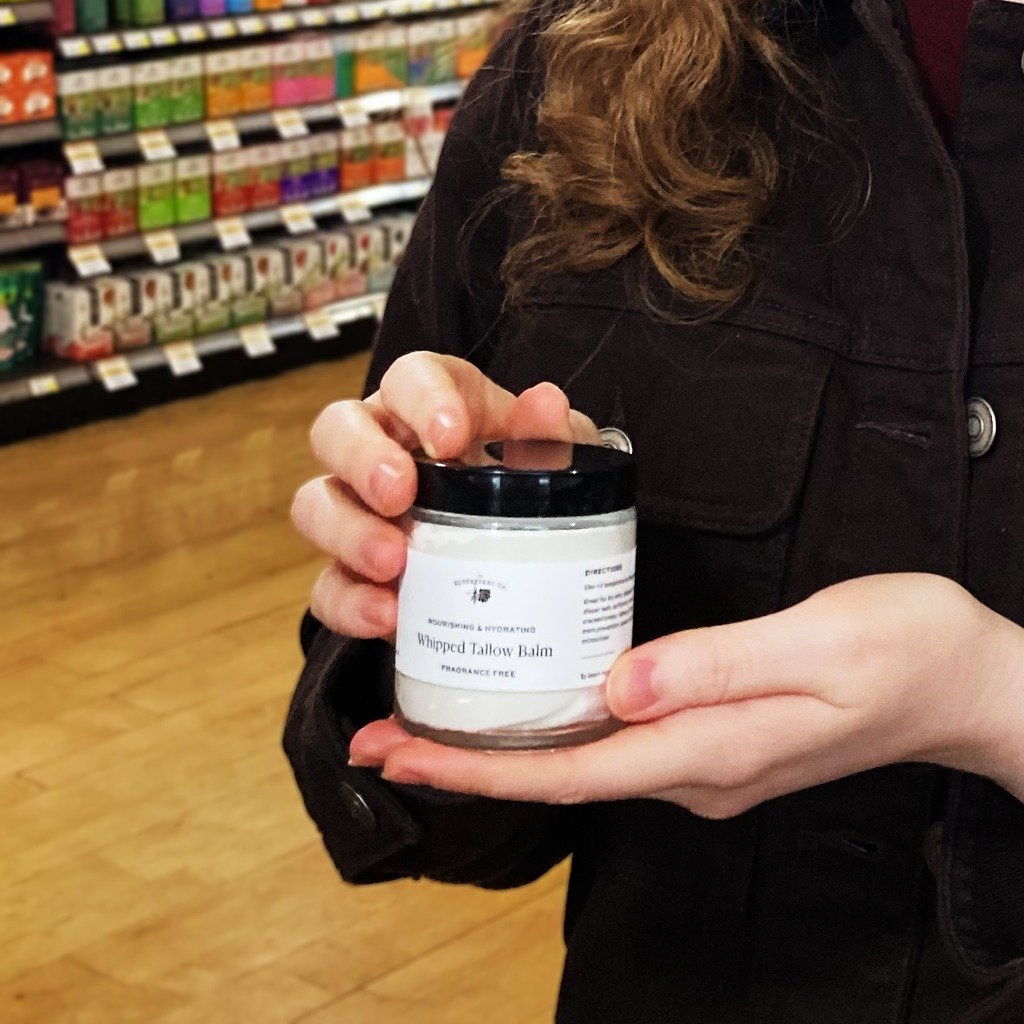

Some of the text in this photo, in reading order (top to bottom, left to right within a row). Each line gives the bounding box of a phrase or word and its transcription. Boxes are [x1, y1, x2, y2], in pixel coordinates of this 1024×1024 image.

[428, 618, 475, 632] NOURISHING
[485, 625, 537, 634] HYDRATING
[417, 632, 553, 658] Whipped Tallow Balm
[441, 664, 516, 678] FRAGRANCE FREE
